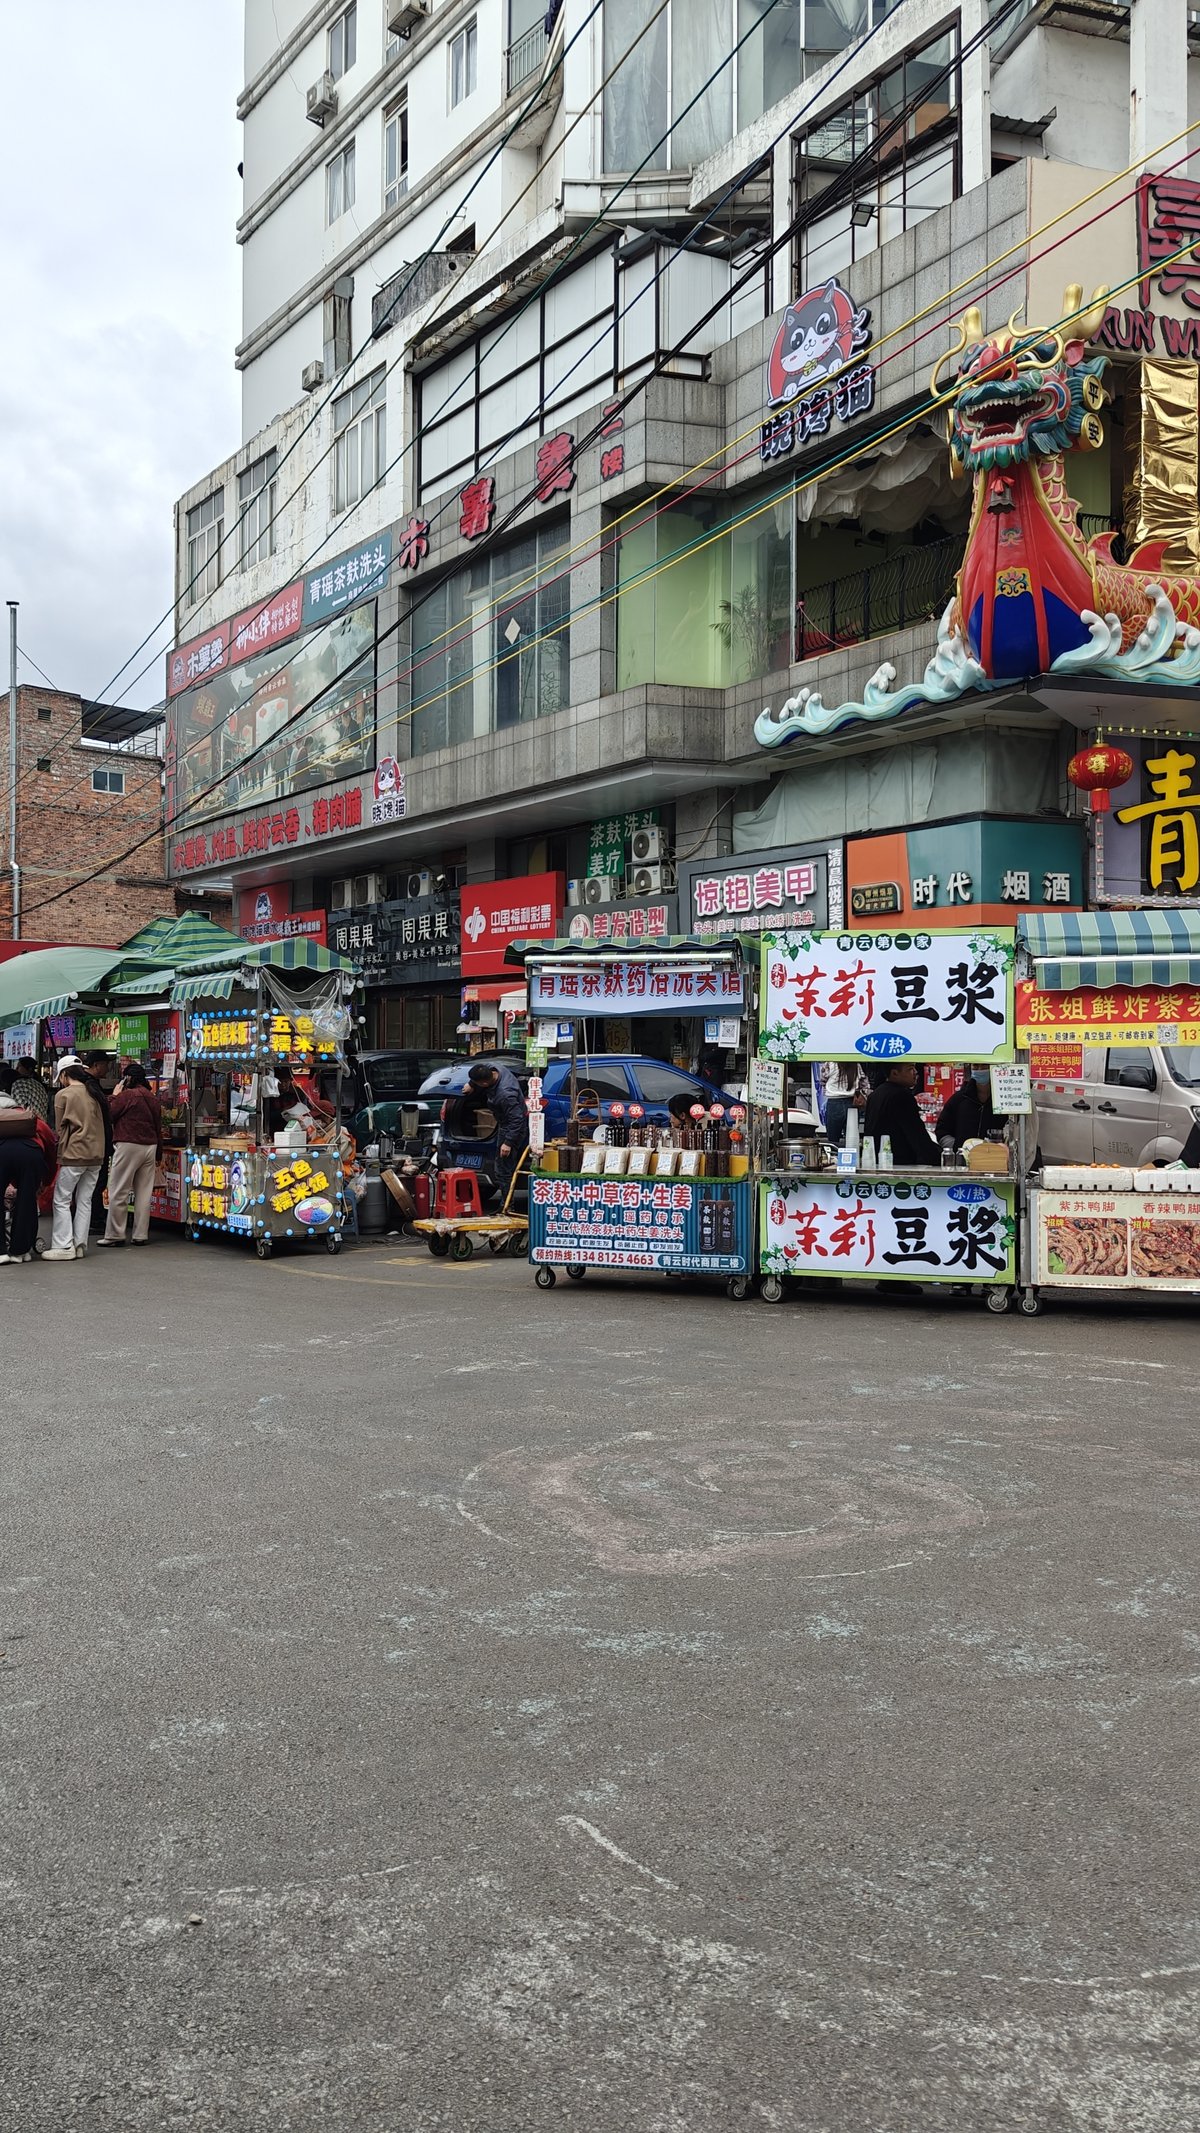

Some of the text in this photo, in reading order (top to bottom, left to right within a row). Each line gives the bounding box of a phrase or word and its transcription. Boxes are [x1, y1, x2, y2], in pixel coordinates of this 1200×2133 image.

[1160, 315, 1200, 358] W
[760, 365, 876, 461] 晓馋猫
[600, 400, 624, 481] 二楼
[309, 543, 386, 606] 青瑶茶麸洗头
[371, 797, 406, 825] 晓馋猫
[1116, 749, 1200, 892] 青
[590, 811, 657, 848] 茶麸洗头
[590, 849, 622, 877] 姜疗
[694, 862, 817, 917] 惊艳美甲
[402, 911, 449, 945] 周果果
[490, 904, 552, 927] 中国福利彩票
[490, 922, 552, 935] CHINA WELFARE LOTTERY
[593, 906, 667, 938] 美发造型
[336, 924, 375, 951] 周果果
[837, 934, 932, 950] 青云第一家
[782, 959, 1005, 1026] 茉莉豆浆
[203, 1021, 249, 1047] 五色糯米饭
[862, 1037, 906, 1054] 冰/热
[1031, 1055, 1081, 1066] 紫苏炸鸭脚
[1035, 1067, 1077, 1078] 十元三个
[530, 1078, 542, 1111] 伴手礼
[201, 1164, 228, 1190] 五色
[273, 1159, 313, 1190] 五色
[189, 1189, 228, 1219] 糯米饭
[271, 1170, 330, 1213] 糯米饭
[533, 1180, 693, 1210] 茶麸+中草药+生姜
[837, 1182, 932, 1199] 青云第一家
[953, 1186, 986, 1200] 冰/热
[1059, 1201, 1116, 1213] 紫苏鸭脚
[1143, 1202, 1200, 1214] 香辣鸭脚
[546, 1222, 685, 1240] 手工代熬茶麸中药生姜洗头
[783, 1199, 1006, 1271] 茉莉豆浆
[598, 1252, 624, 1264] 8125
[627, 1253, 654, 1265] 4663
[662, 1255, 740, 1269] 青云时代商厦二楼
